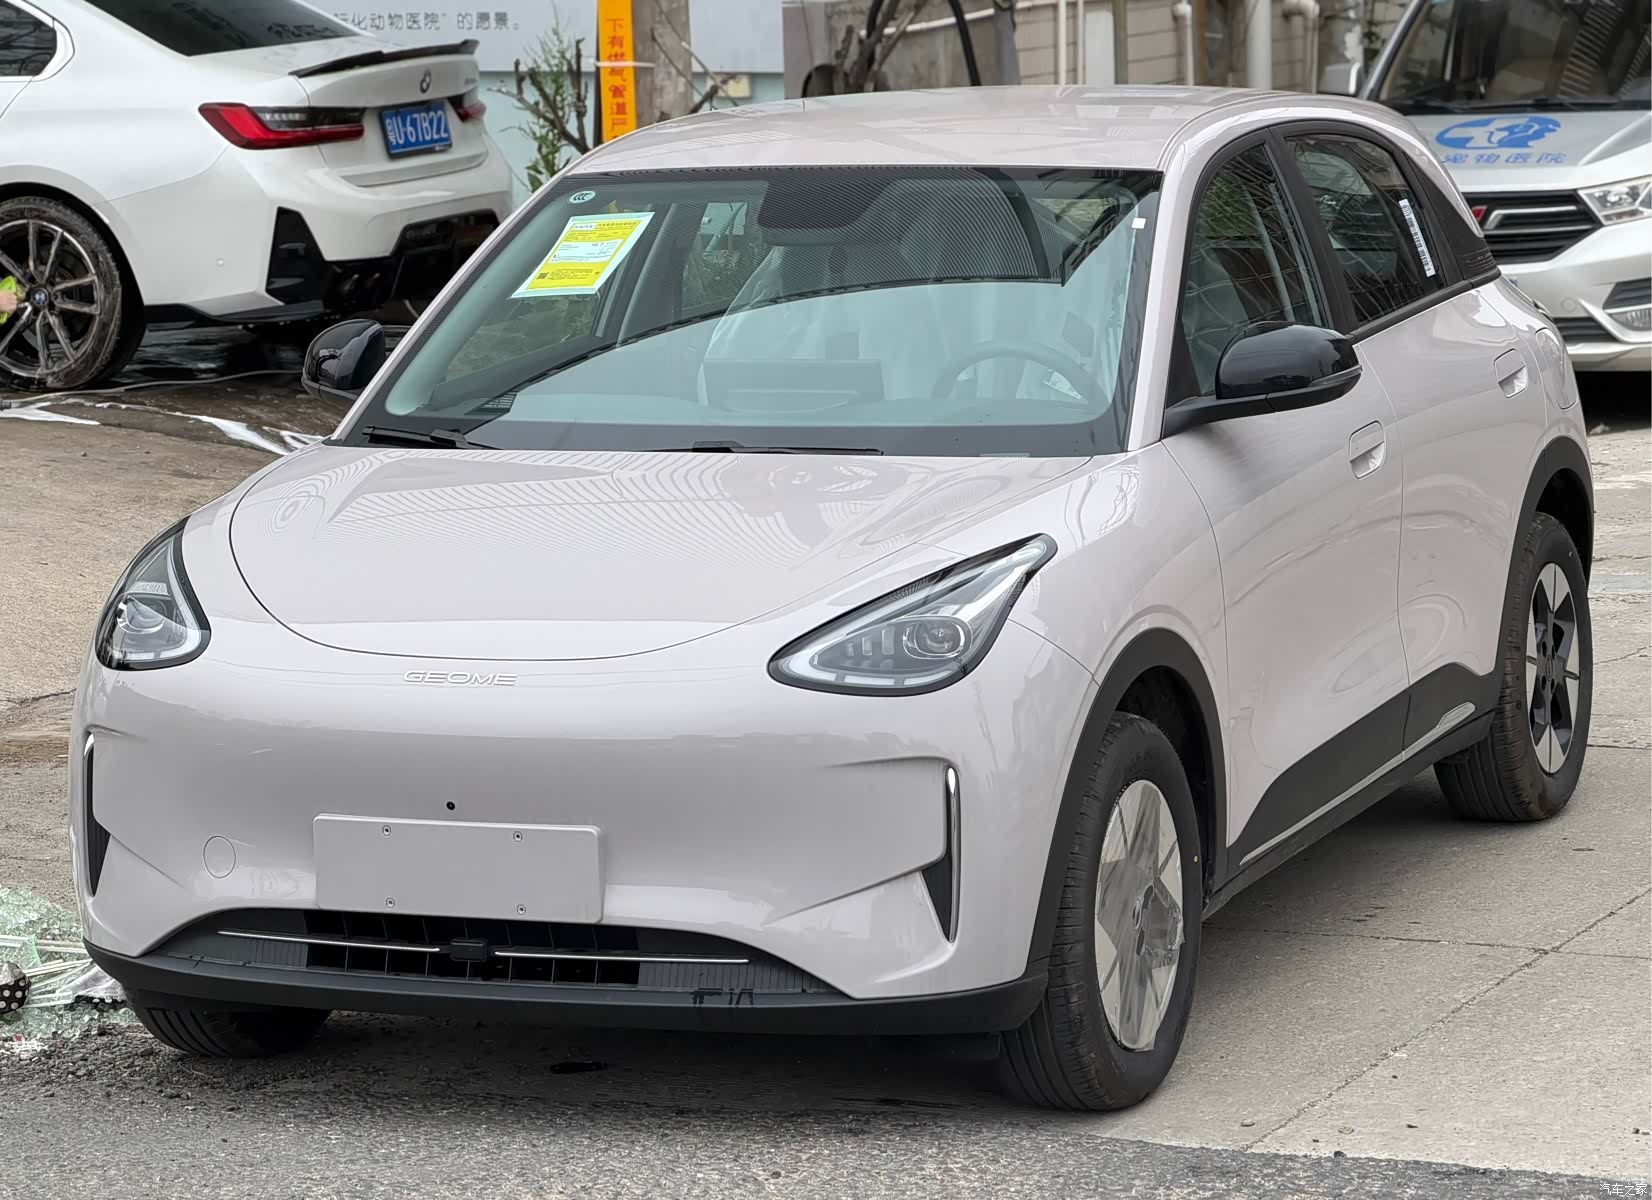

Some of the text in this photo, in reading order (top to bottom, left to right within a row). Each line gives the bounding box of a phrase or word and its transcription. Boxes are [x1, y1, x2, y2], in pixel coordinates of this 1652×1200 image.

[606, 18, 628, 141] 下有燃气管道严
[403, 670, 518, 687] GEOME
